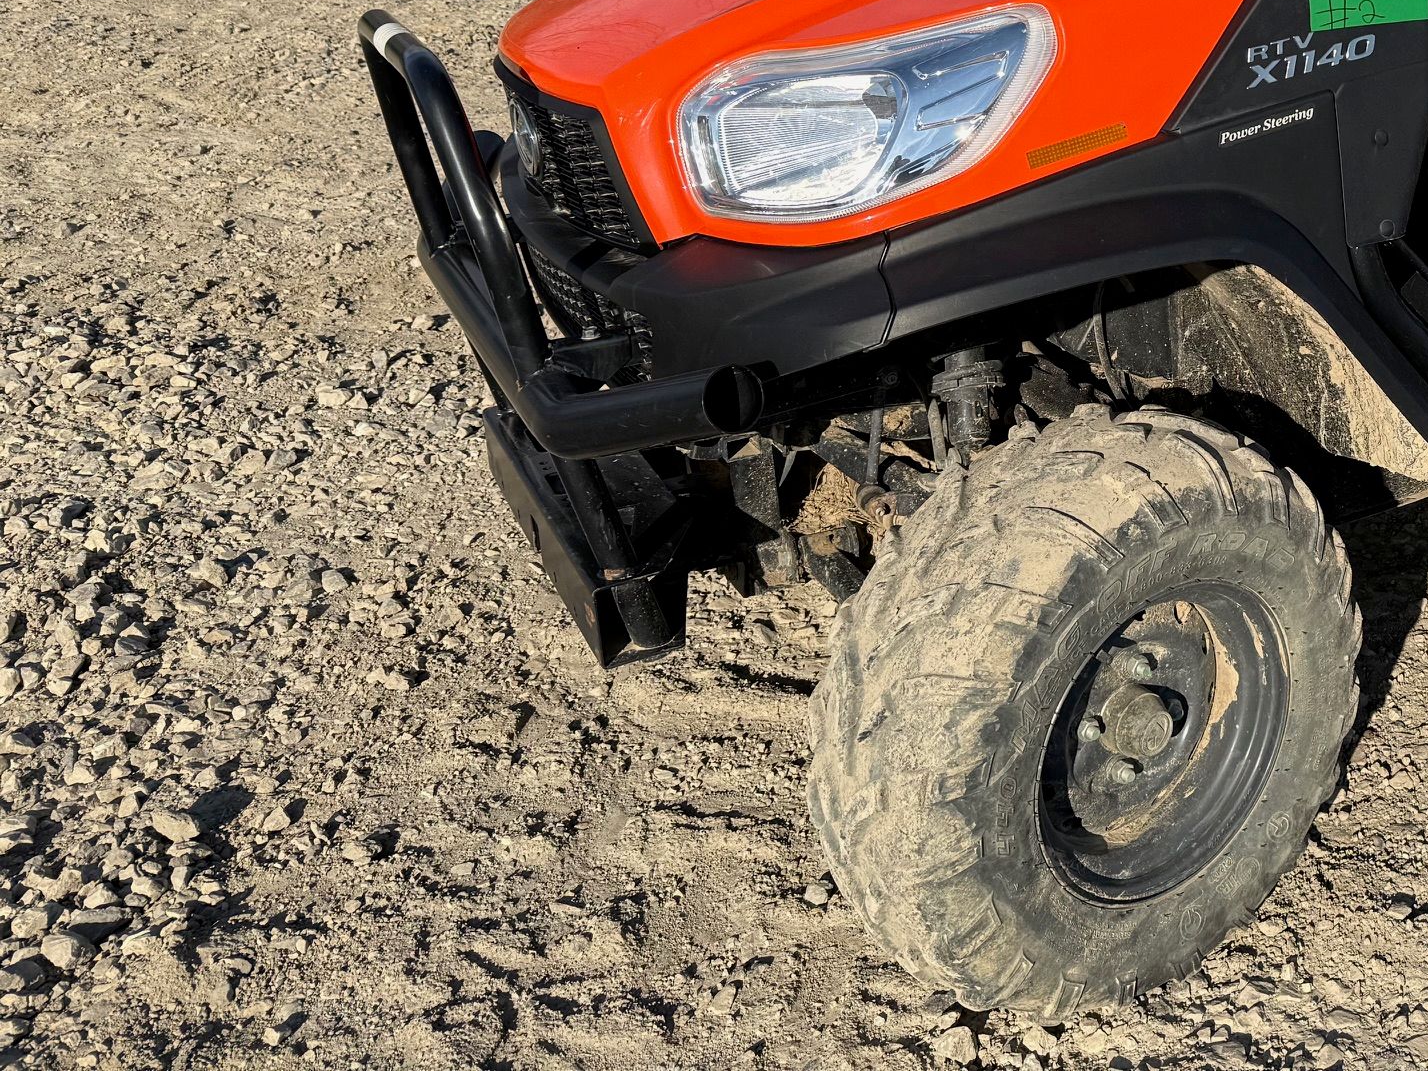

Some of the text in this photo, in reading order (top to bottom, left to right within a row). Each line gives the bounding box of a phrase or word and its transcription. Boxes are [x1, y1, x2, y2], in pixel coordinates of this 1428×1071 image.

[1246, 33, 1376, 90] X1140
[1247, 32, 1314, 65] RTV
[1219, 106, 1314, 146] Power Steering
[1097, 539, 1180, 614] OFF
[1188, 531, 1296, 572] ROAD
